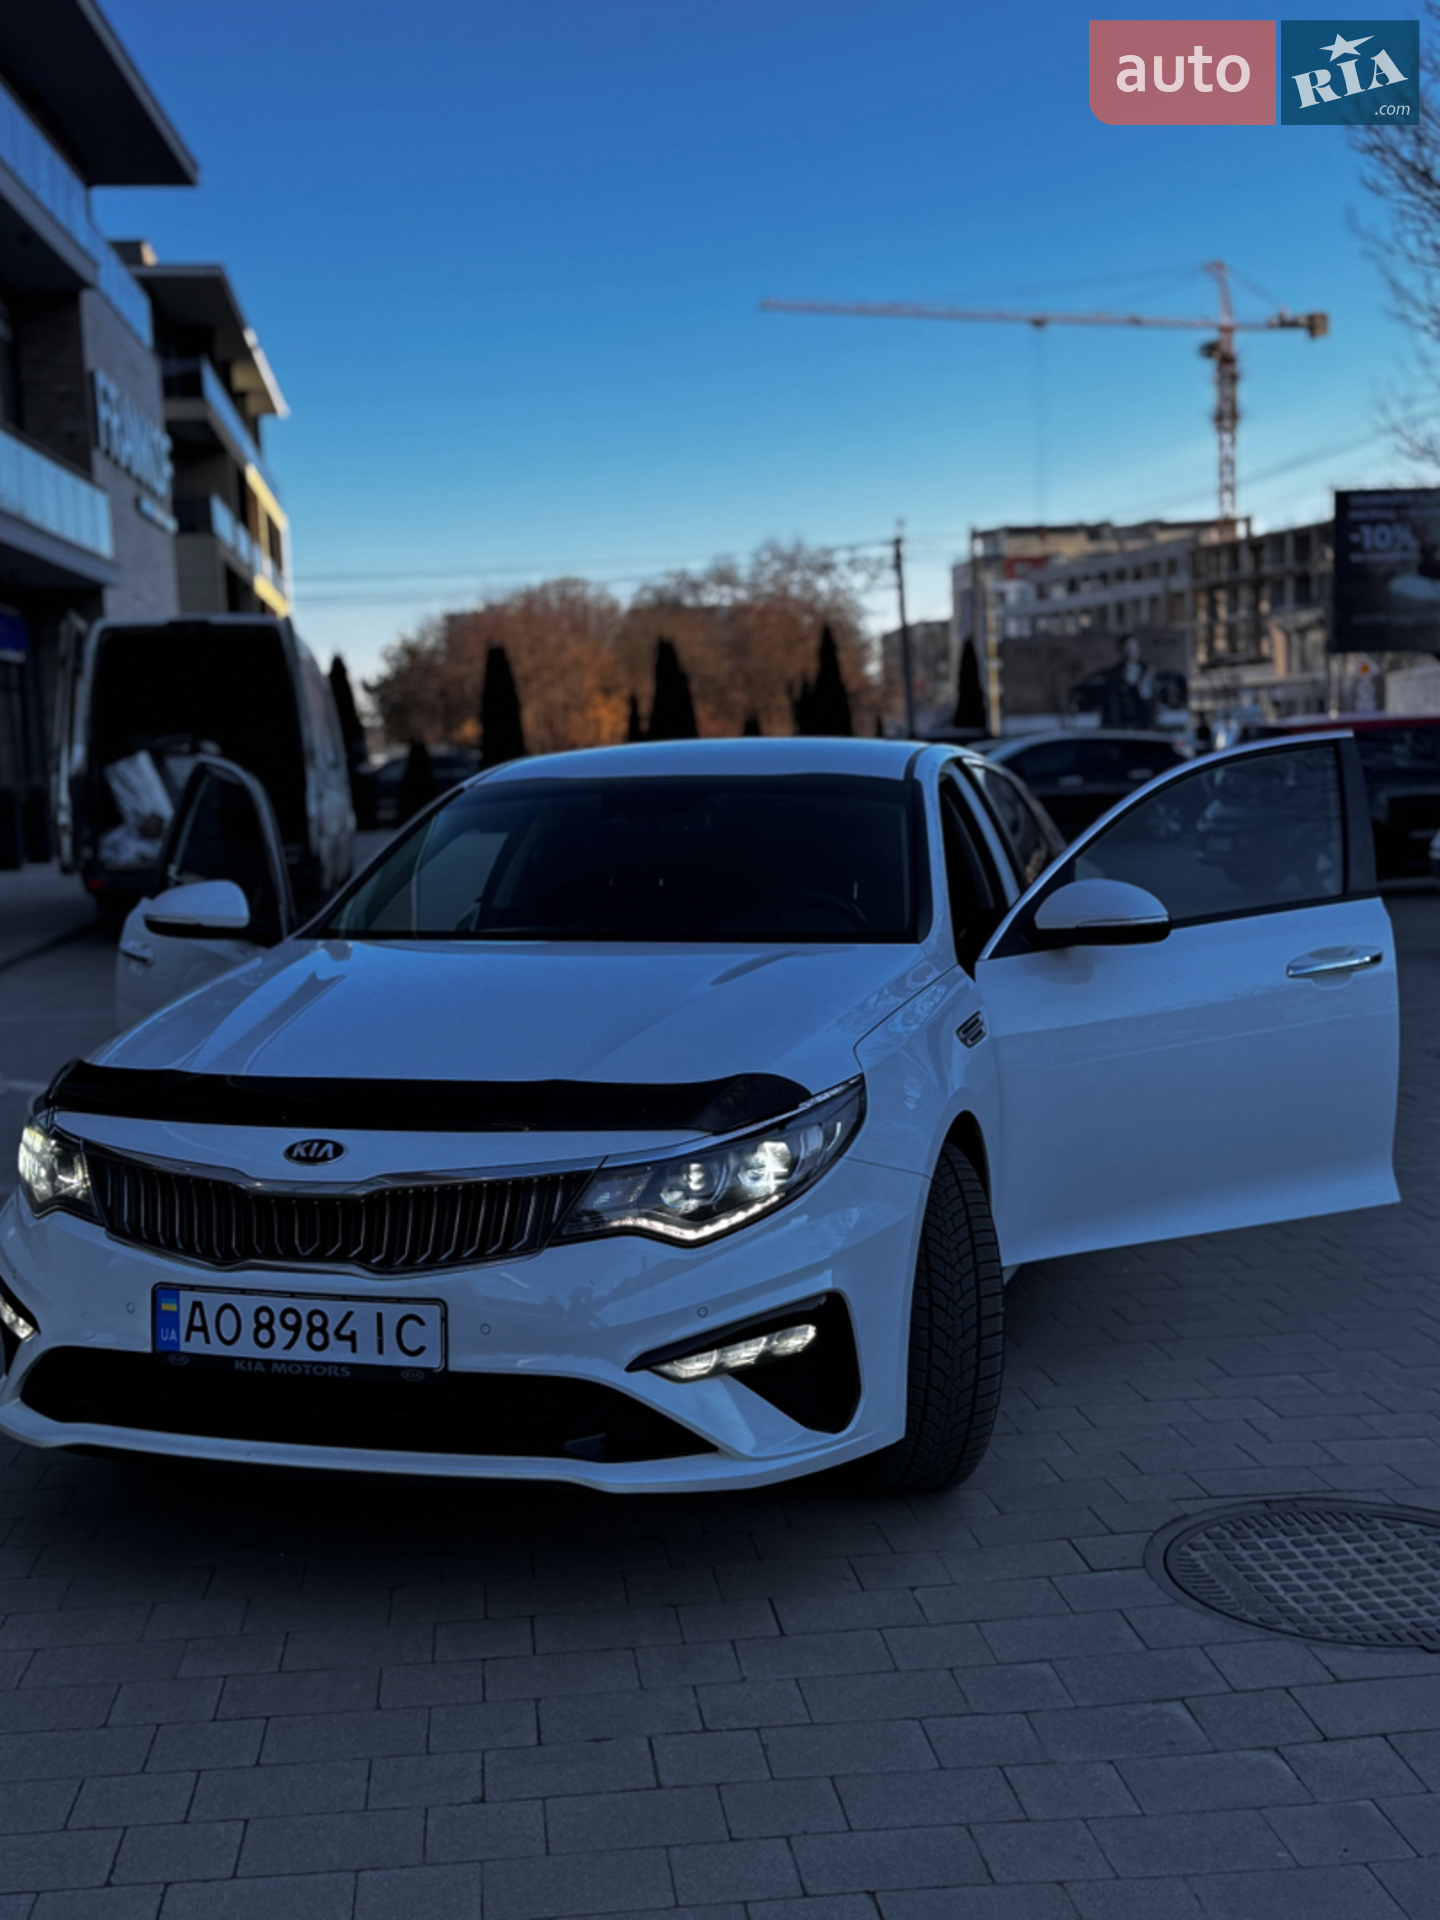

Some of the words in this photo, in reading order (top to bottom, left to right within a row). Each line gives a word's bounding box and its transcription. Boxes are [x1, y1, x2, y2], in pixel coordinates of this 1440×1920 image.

[291, 1141, 335, 1159] KIA
[161, 1328, 178, 1342] UA
[185, 1301, 242, 1346] AO
[252, 1306, 358, 1354] 8984
[376, 1312, 427, 1357] IC
[234, 1359, 267, 1374] KIA
[271, 1361, 352, 1379] MOTORS
